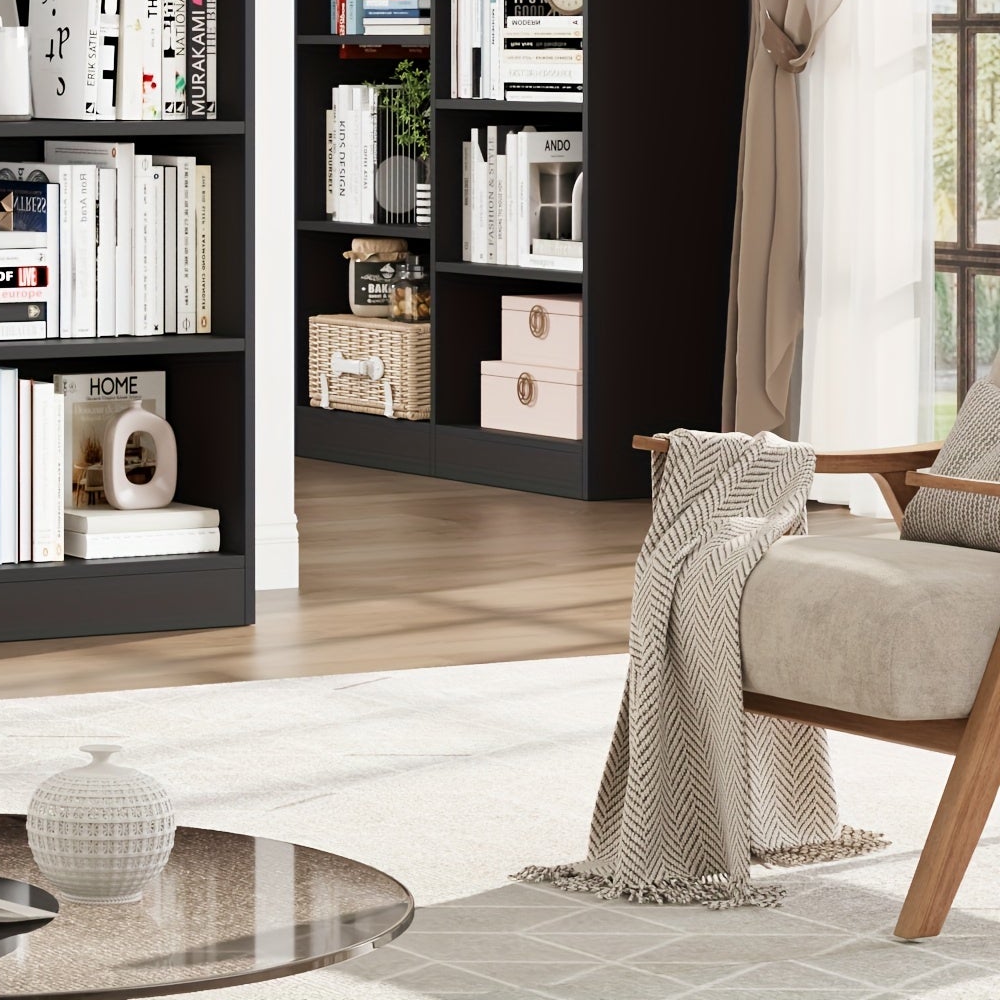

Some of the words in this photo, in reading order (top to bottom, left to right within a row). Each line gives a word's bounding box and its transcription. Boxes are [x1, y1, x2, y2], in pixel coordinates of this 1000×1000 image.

[88, 29, 98, 60] SATIE
[192, 10, 206, 116] MURAKAMI
[87, 64, 96, 87] ERIK
[544, 139, 571, 152] ANDO
[17, 267, 38, 287] LIVE
[1, 288, 42, 299] europe
[89, 376, 138, 397] HOME
